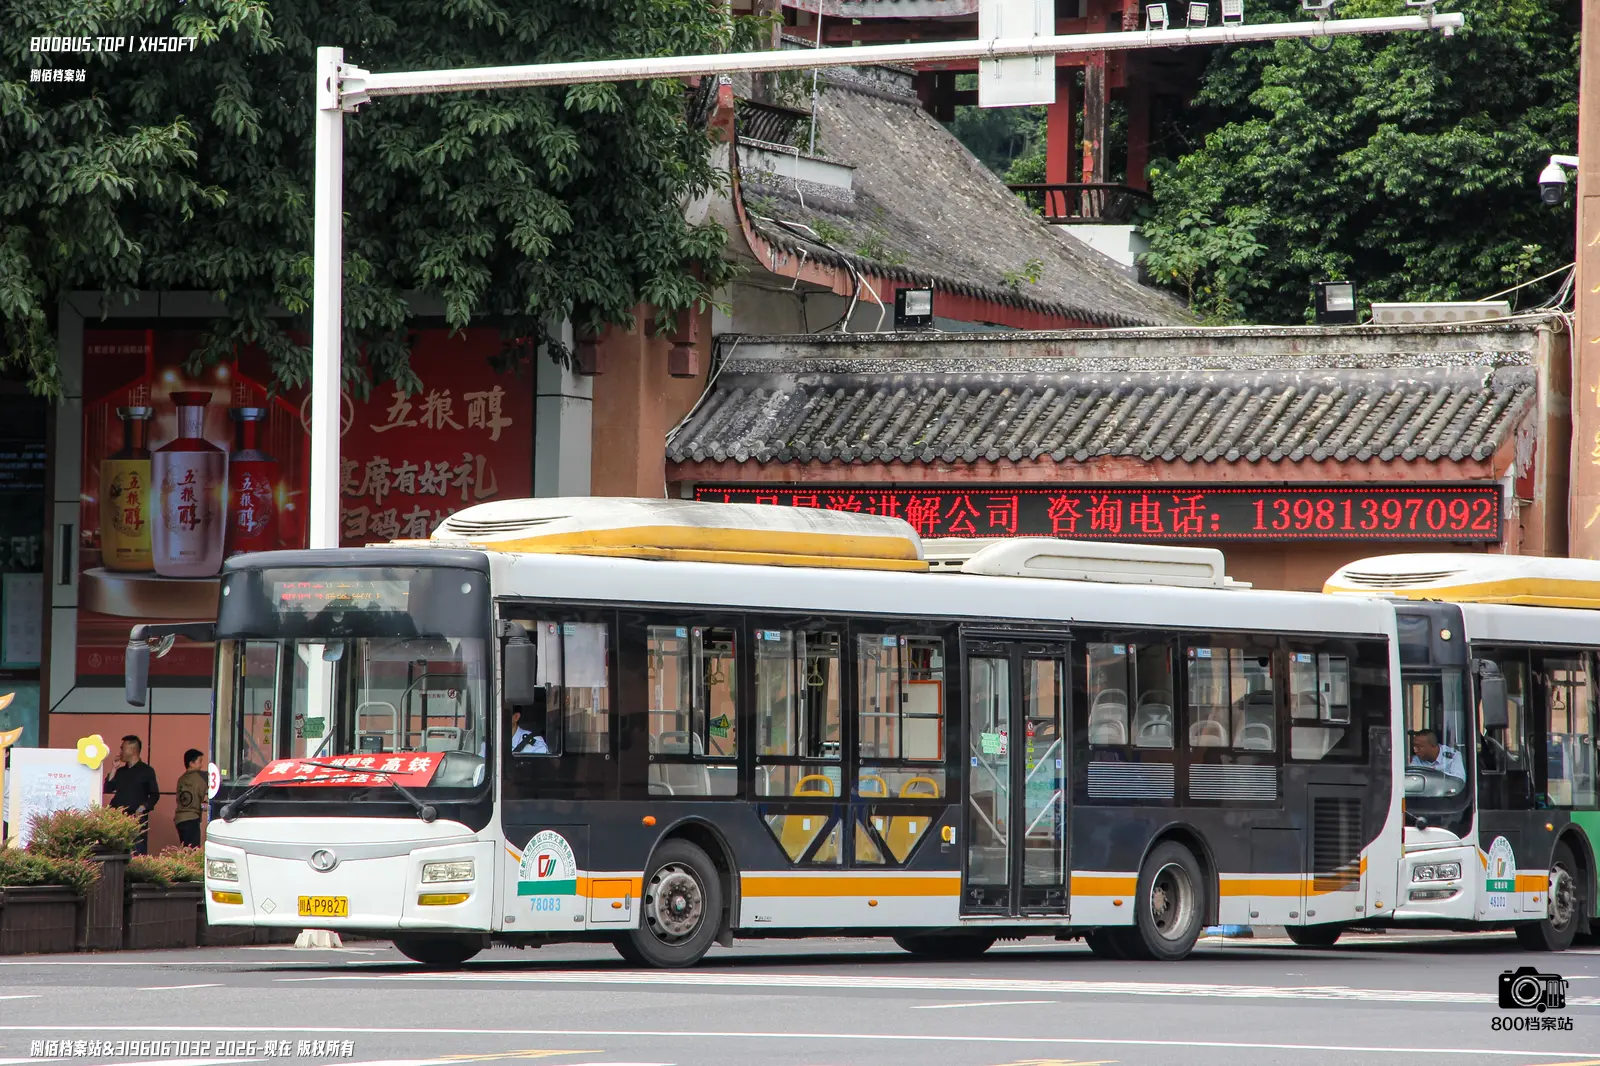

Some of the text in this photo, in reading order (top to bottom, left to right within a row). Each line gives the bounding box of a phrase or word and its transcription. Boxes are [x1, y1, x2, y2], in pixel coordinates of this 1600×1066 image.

[370, 385, 513, 442] 五粮醇
[123, 475, 145, 531] 五粮醇
[177, 469, 201, 532] 五粮醇
[235, 477, 258, 533] 五粮醇
[1252, 498, 1492, 531] 13981397092
[380, 756, 432, 772] 高铁
[530, 897, 561, 912] 78083
